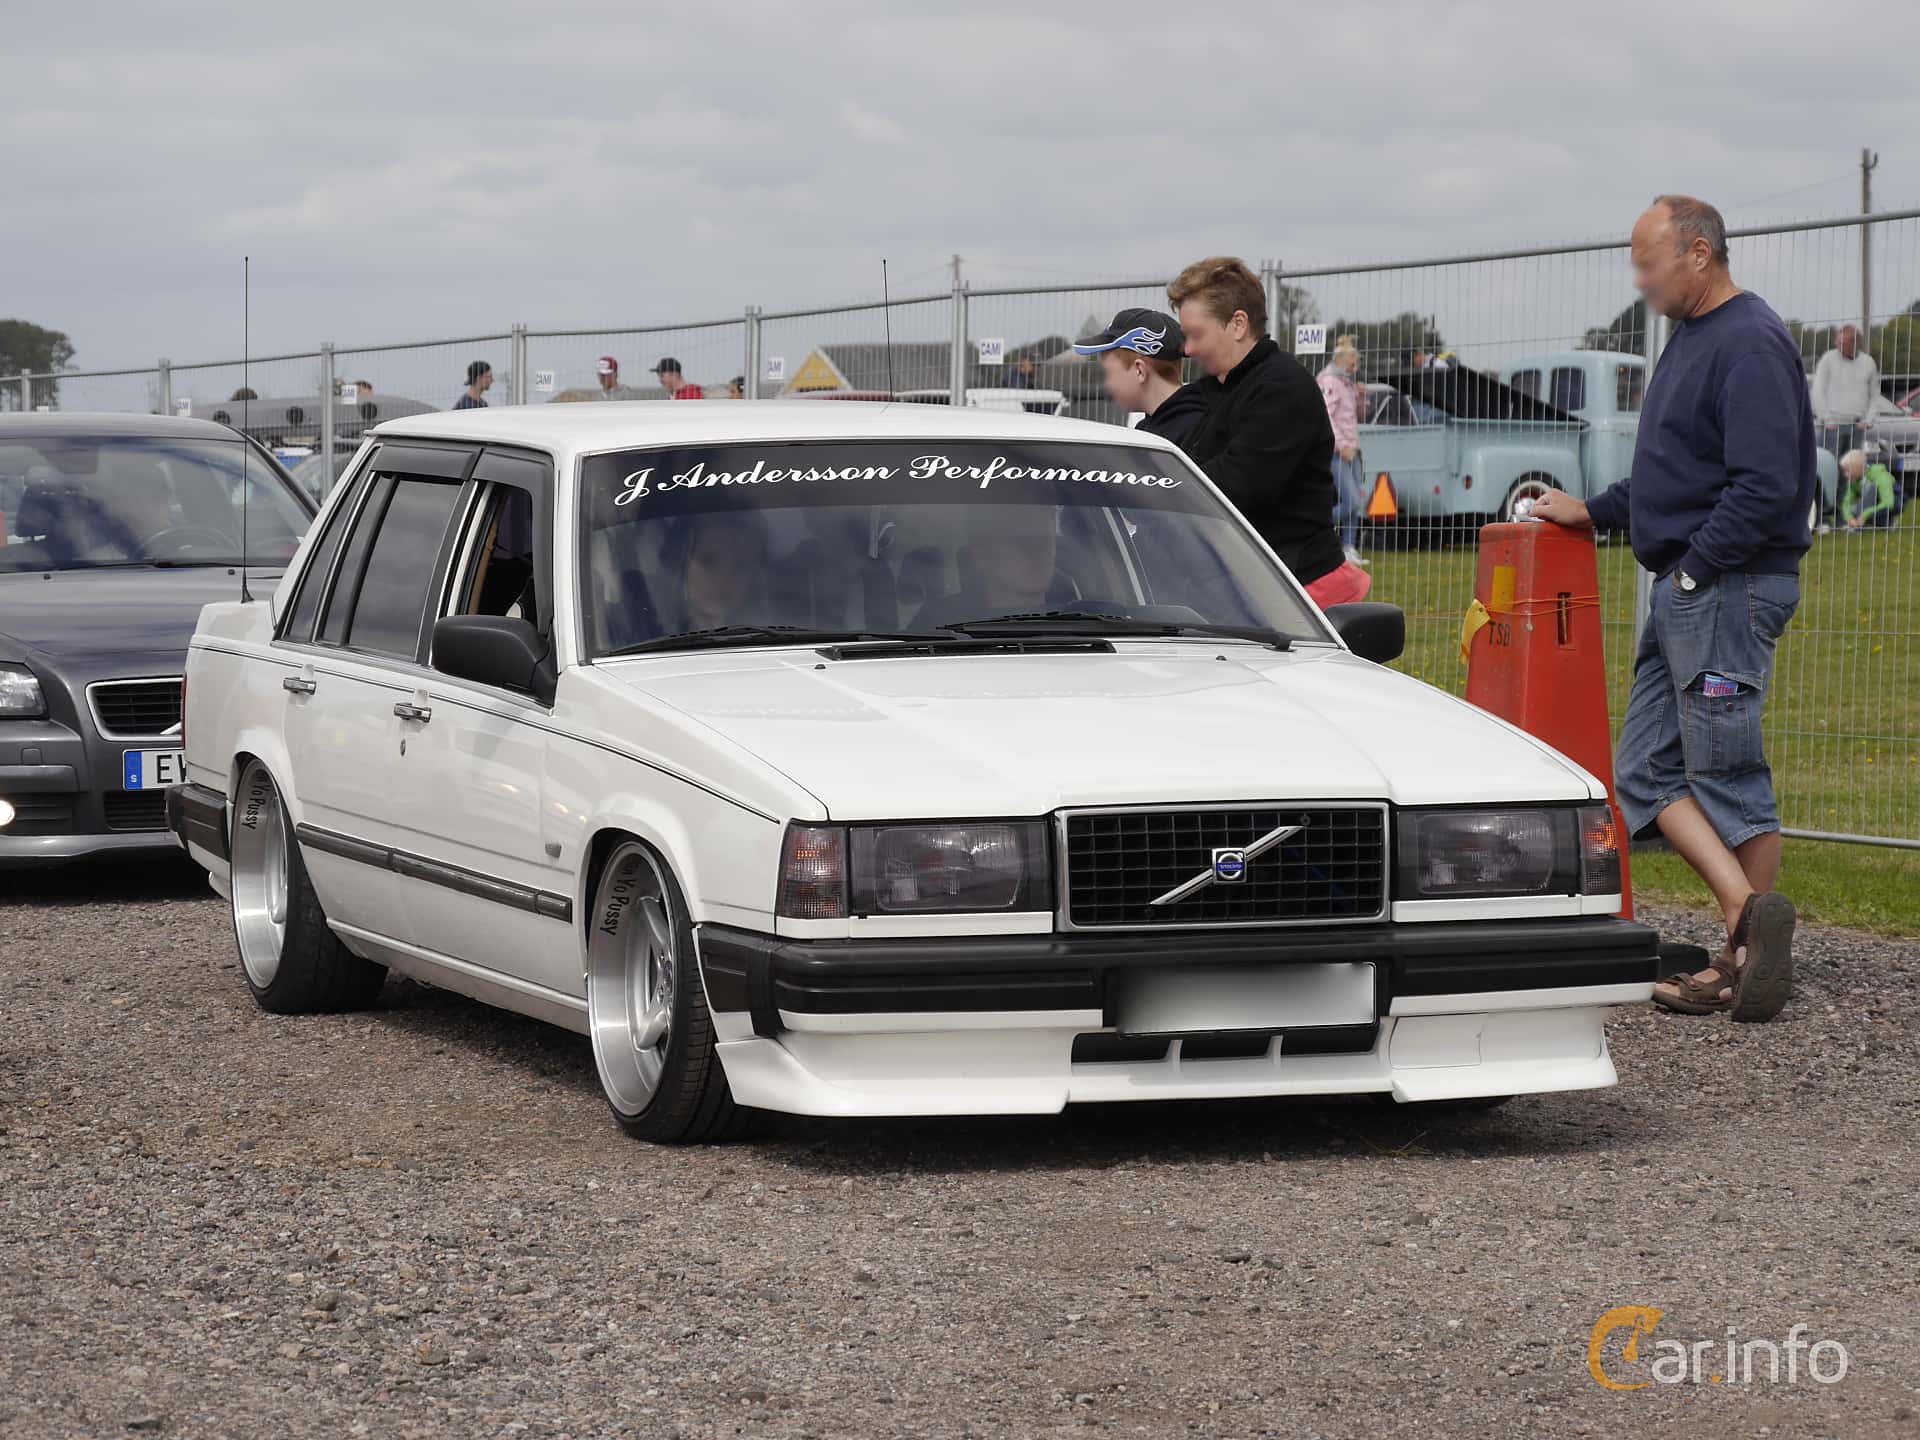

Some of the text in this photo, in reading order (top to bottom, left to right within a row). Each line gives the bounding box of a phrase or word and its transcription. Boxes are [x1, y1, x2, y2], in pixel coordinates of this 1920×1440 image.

[1298, 329, 1323, 344] CAMI
[614, 455, 1183, 506] J Andersson Performance
[130, 774, 138, 783] S
[241, 798, 266, 830] Pussy
[614, 879, 637, 893] Yo
[600, 896, 630, 936] Pussy
